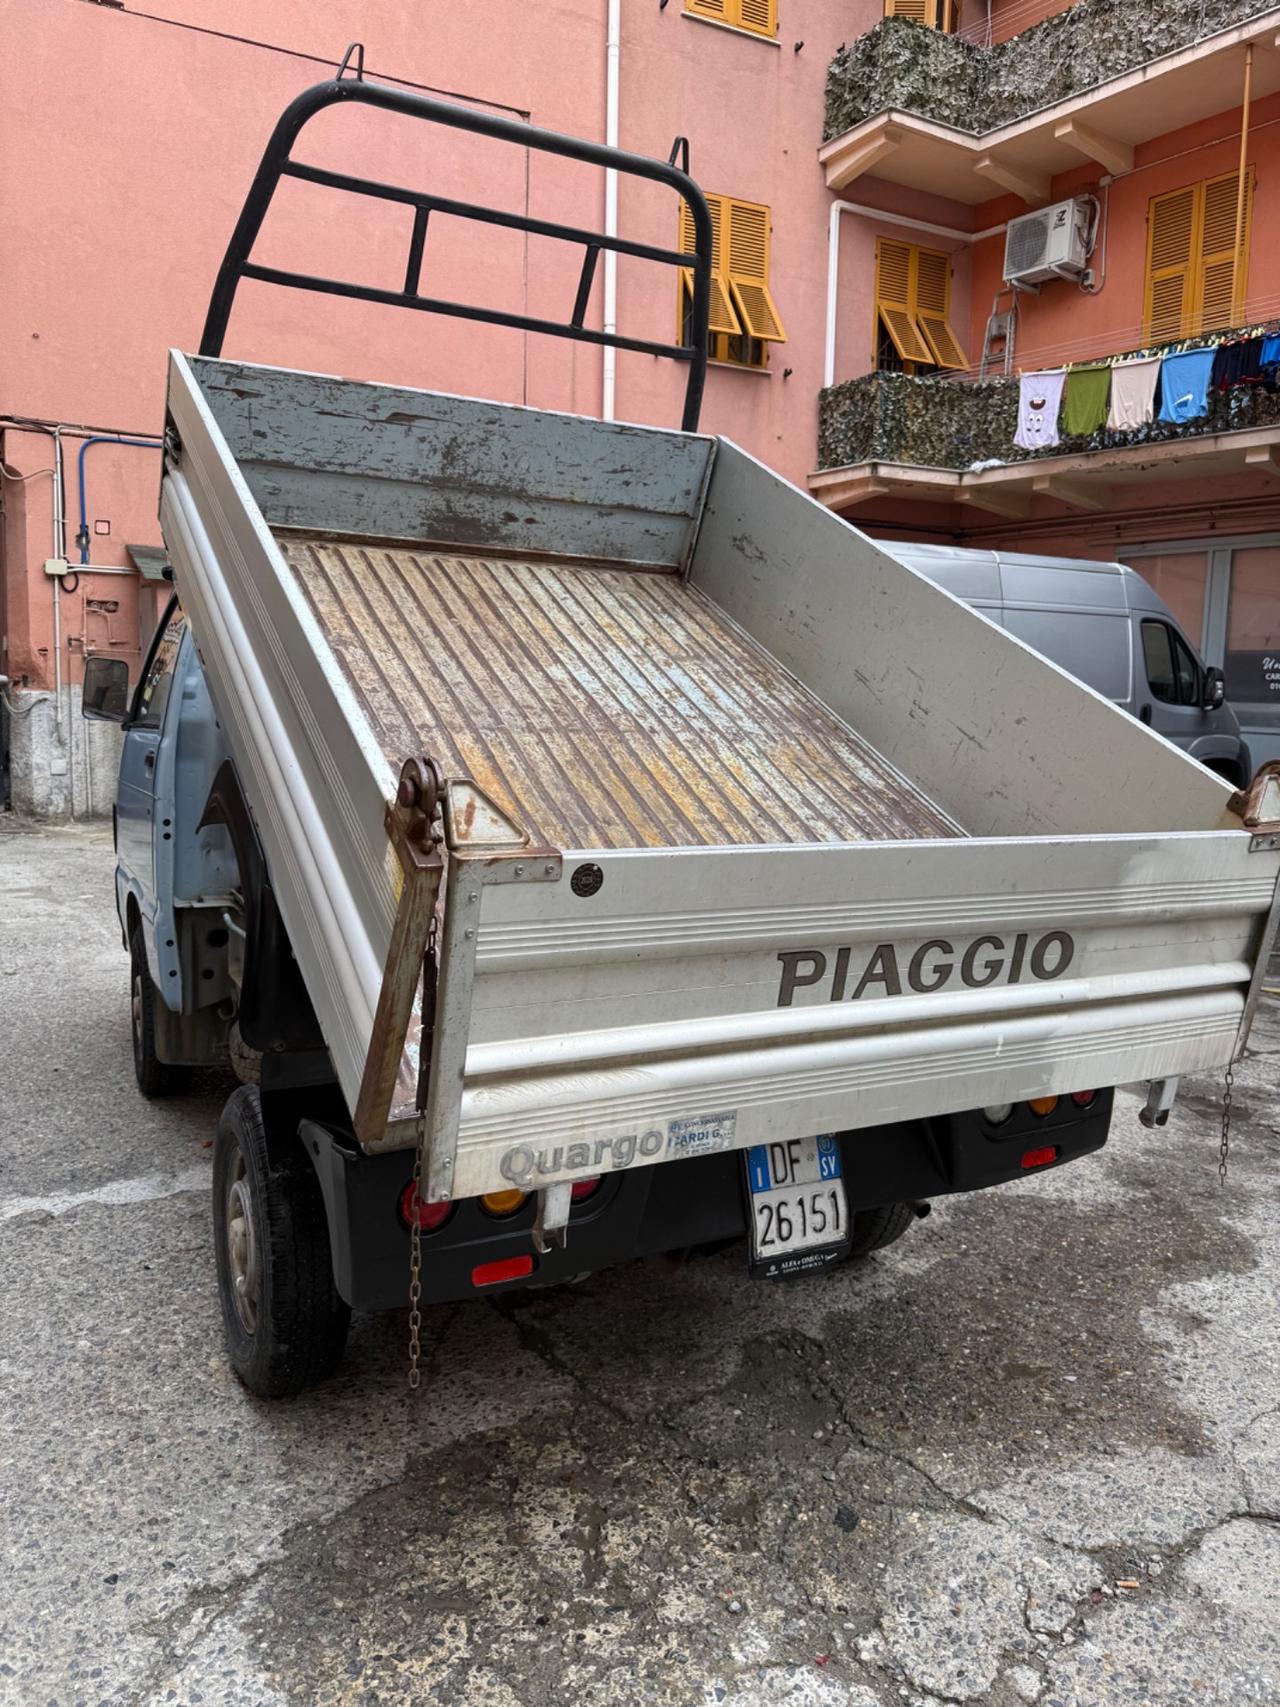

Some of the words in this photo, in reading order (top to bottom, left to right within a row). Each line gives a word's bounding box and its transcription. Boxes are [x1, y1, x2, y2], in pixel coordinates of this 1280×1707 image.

[777, 931, 1074, 1007] PIAGGIO
[500, 1131, 663, 1185] Quargo
[770, 1139, 802, 1184] DF
[821, 1155, 836, 1176] SV
[759, 1190, 840, 1247] 26151
